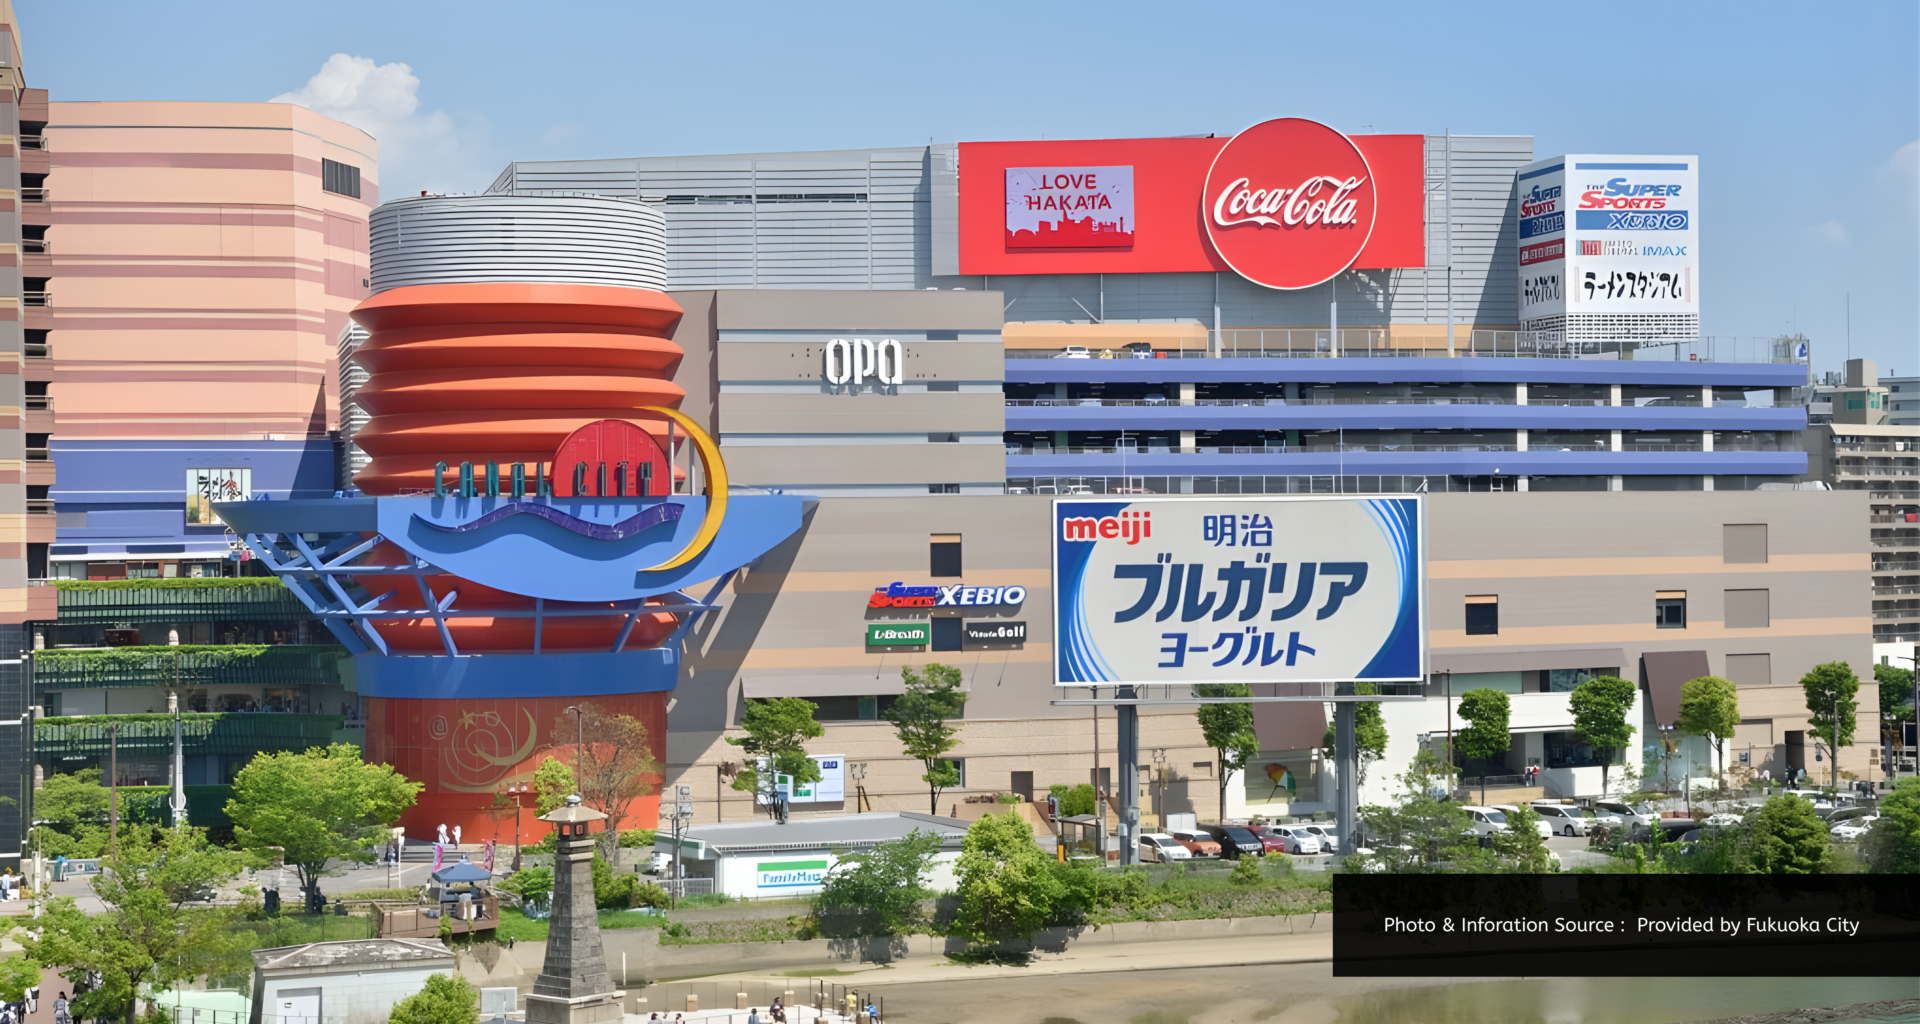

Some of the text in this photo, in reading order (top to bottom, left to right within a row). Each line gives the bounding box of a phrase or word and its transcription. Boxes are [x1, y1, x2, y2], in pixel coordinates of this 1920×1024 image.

[1039, 174, 1097, 190] LOVE
[1603, 177, 1682, 197] SUPER
[1026, 194, 1112, 211] HAKATA
[1578, 190, 1666, 209] SPORTS
[1643, 245, 1688, 256] IMAX
[434, 460, 653, 497] CANAL CITY
[1064, 510, 1152, 546] meiji
[1203, 513, 1274, 547] 明治
[936, 583, 1027, 606] XEBIO
[1113, 552, 1369, 624] ブルガリア
[1157, 626, 1316, 669] ヨーグルト
